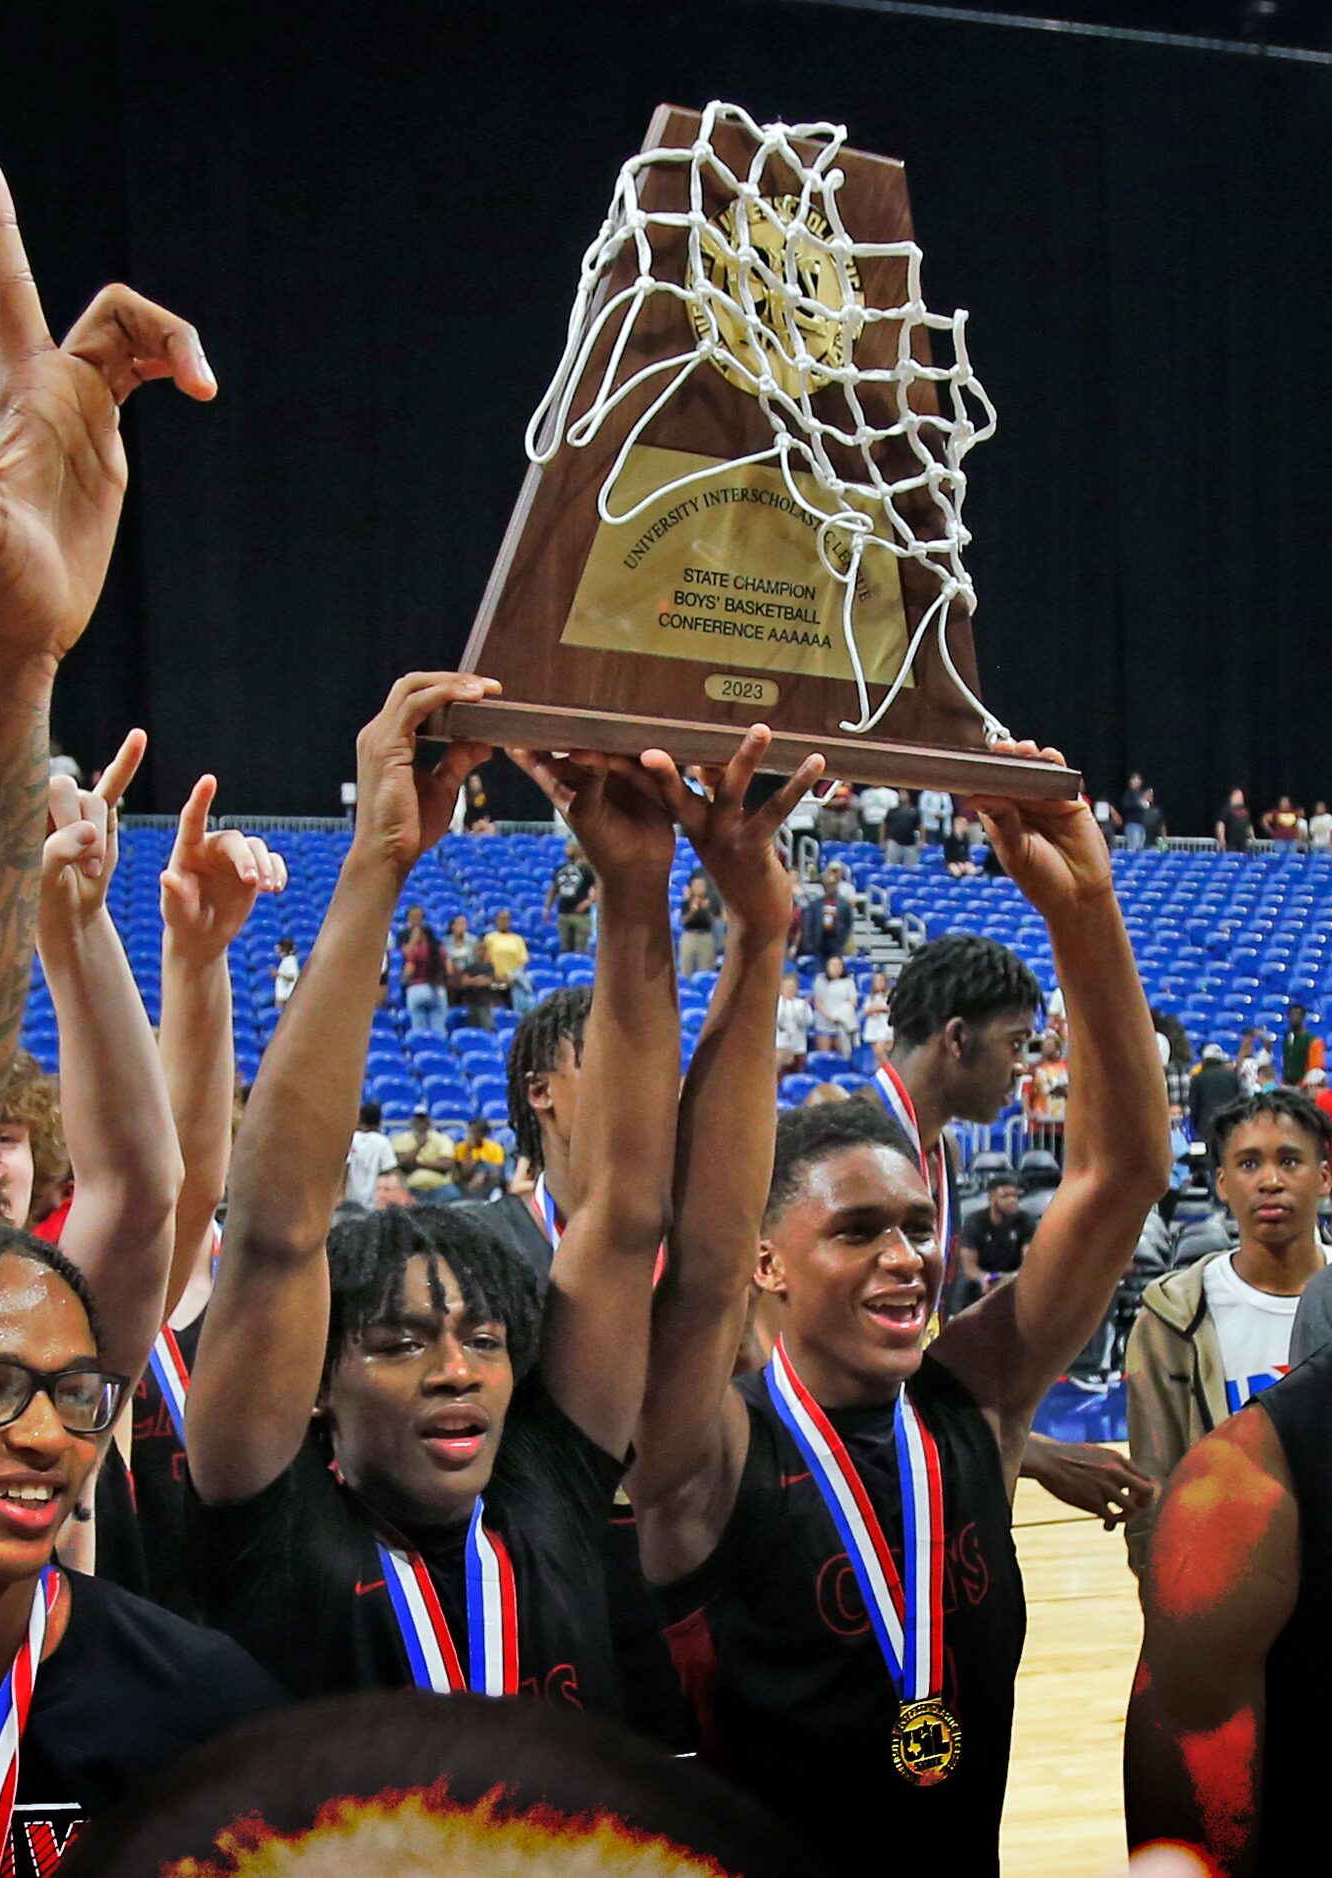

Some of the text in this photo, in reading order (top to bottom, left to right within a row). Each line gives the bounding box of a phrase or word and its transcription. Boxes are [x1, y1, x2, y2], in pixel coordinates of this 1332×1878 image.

[623, 496, 701, 570] UNIVERSITY
[705, 487, 835, 543] INTERSCHOLASTC
[683, 567, 816, 600] STATE CHAMPION
[674, 590, 821, 625] BOYS' BASKETBALL
[658, 612, 832, 649] CONFERENCE AAAAAA
[722, 679, 763, 700] 2023
